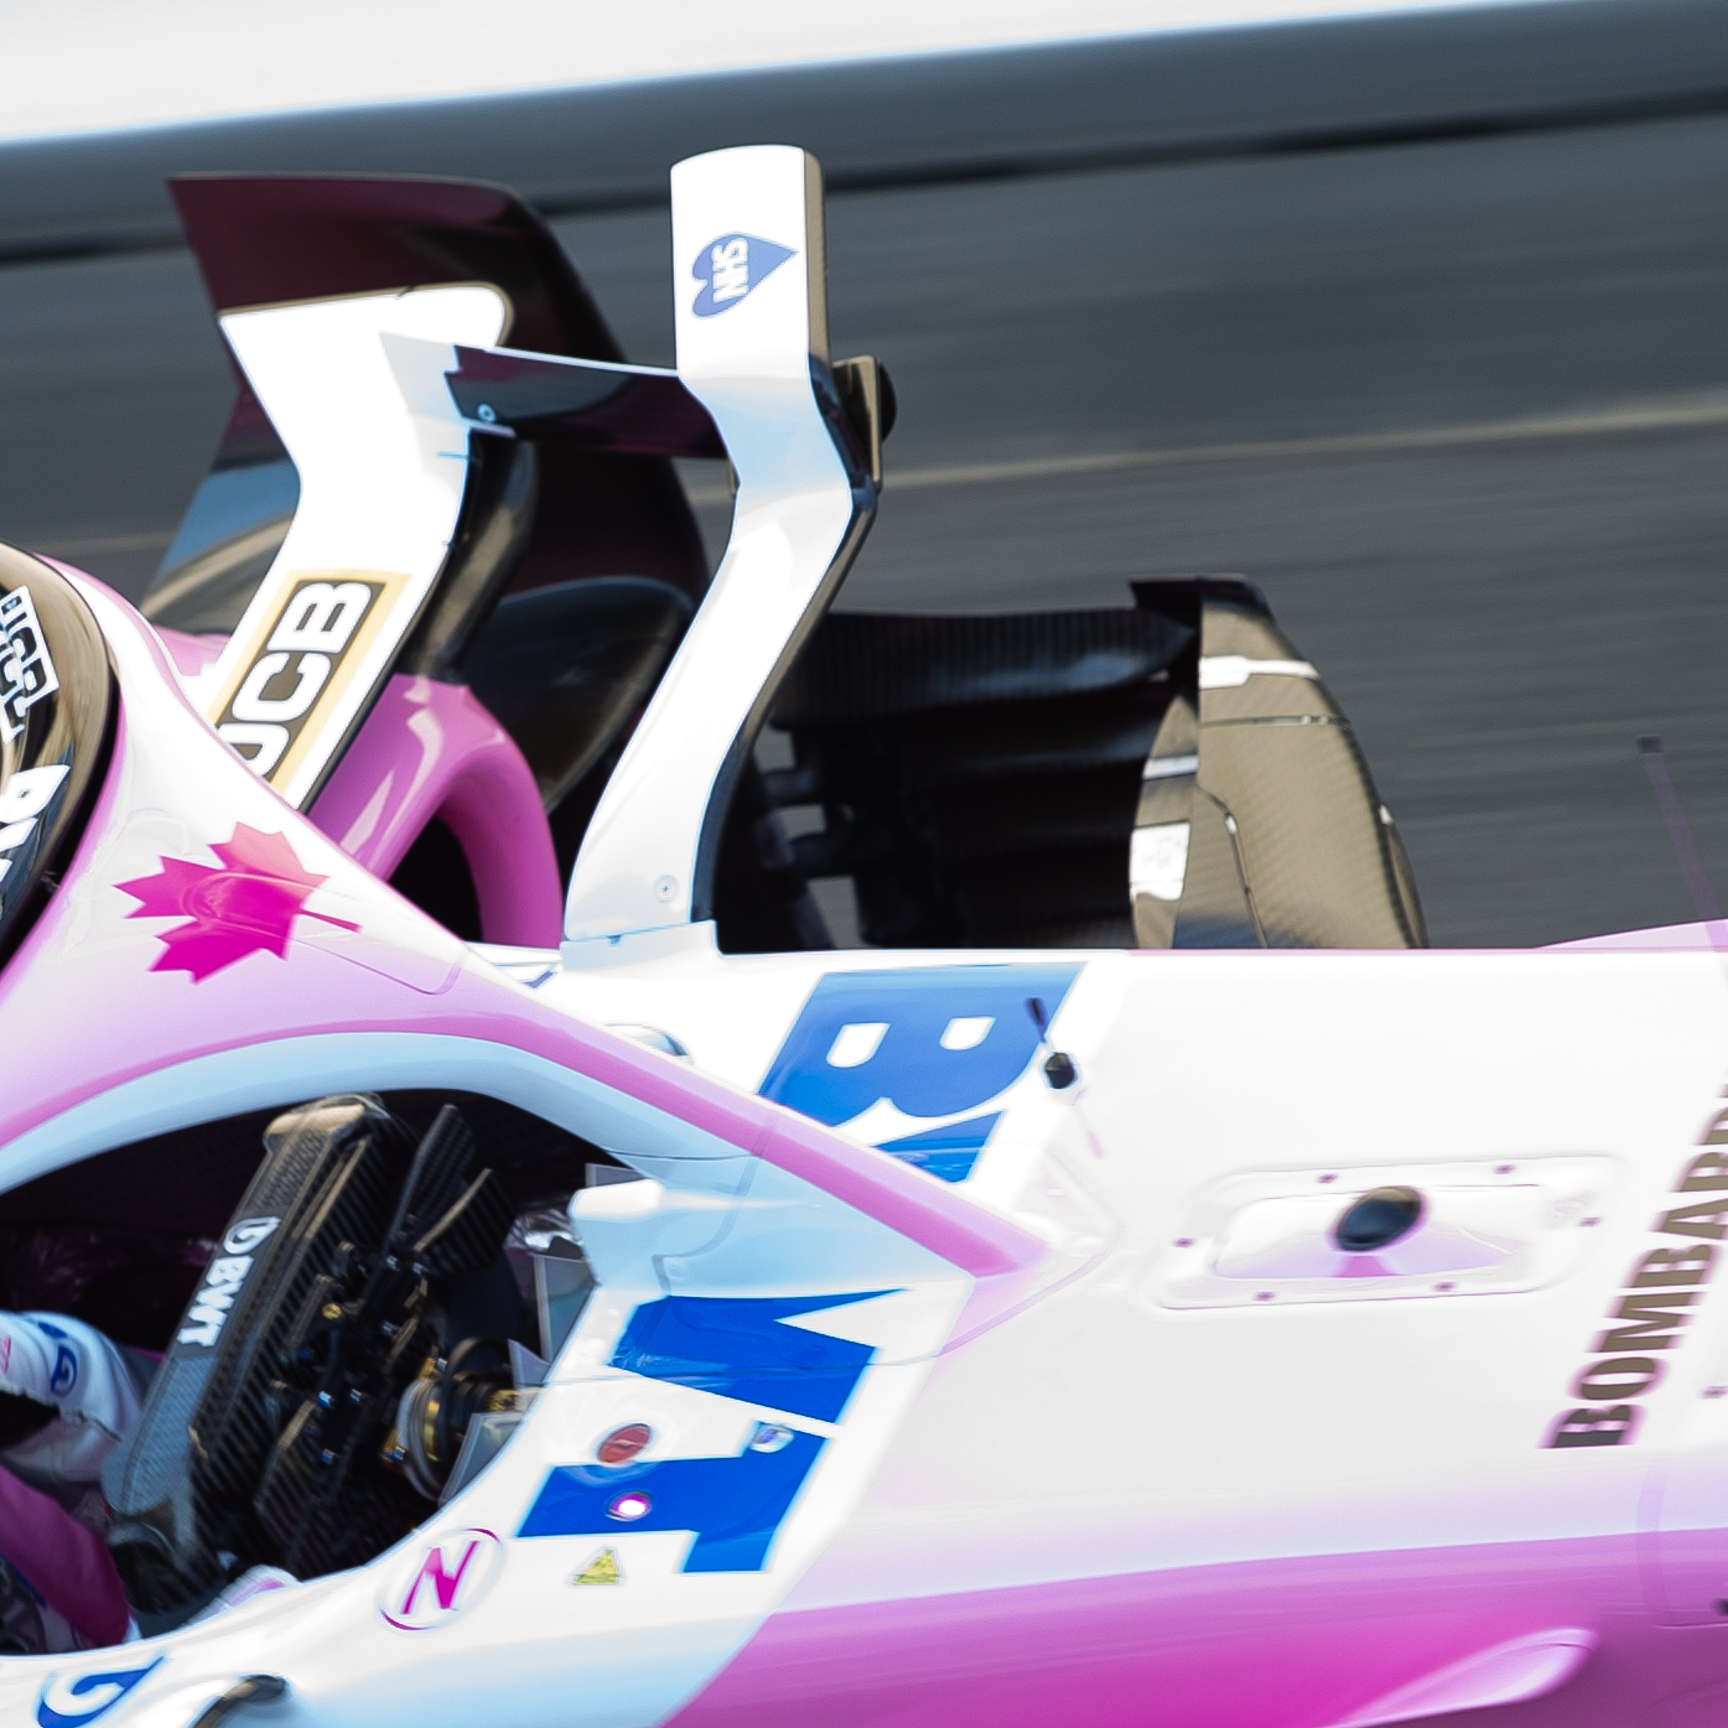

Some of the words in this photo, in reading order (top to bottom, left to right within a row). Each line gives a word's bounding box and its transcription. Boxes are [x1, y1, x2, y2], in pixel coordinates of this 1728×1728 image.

[712, 236, 749, 304] NHS
[217, 582, 373, 778] JCB
[177, 1255, 254, 1346] BWT
